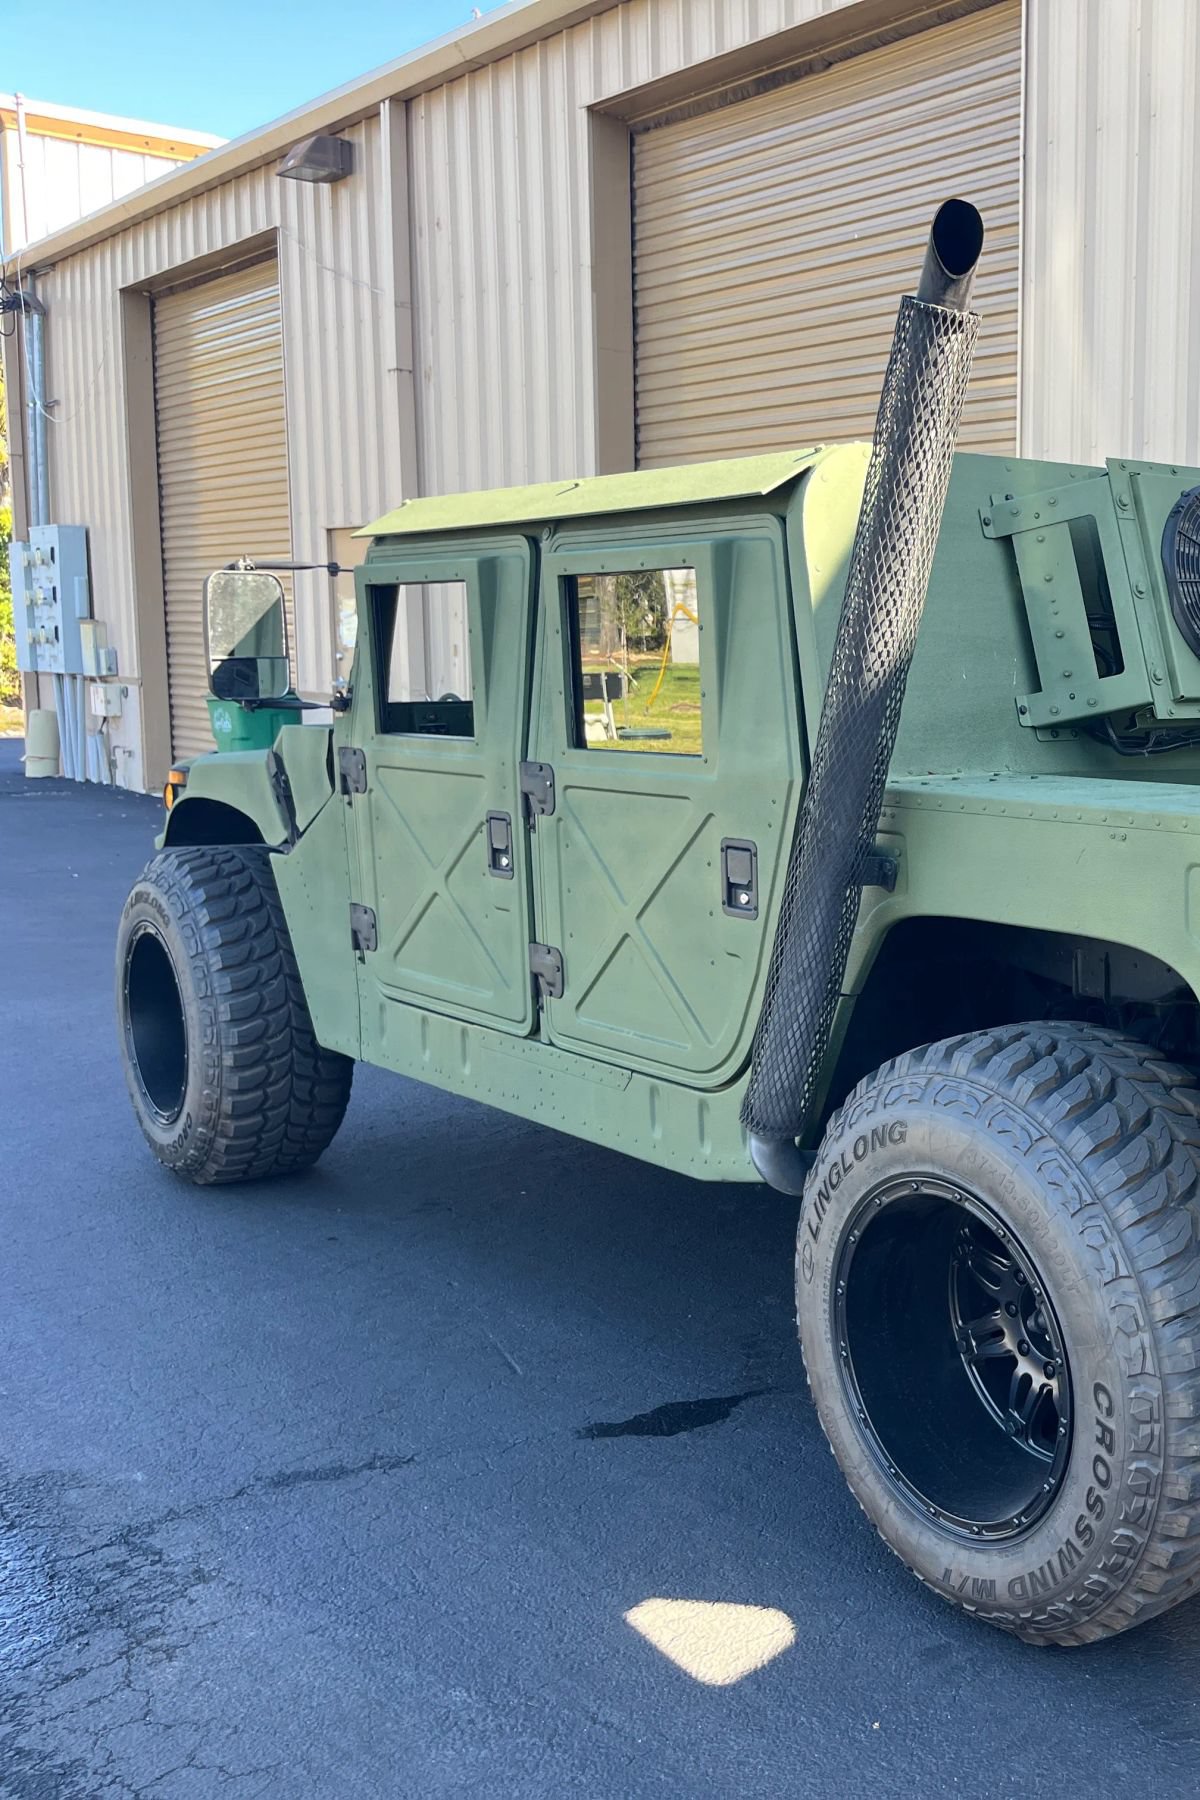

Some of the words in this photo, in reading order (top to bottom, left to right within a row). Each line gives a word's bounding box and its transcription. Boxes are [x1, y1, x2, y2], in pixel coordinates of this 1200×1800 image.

[806, 1119, 908, 1245] LINGLONG
[1007, 1381, 1116, 1601] CROSSWIND
[935, 1566, 997, 1601] M/T
